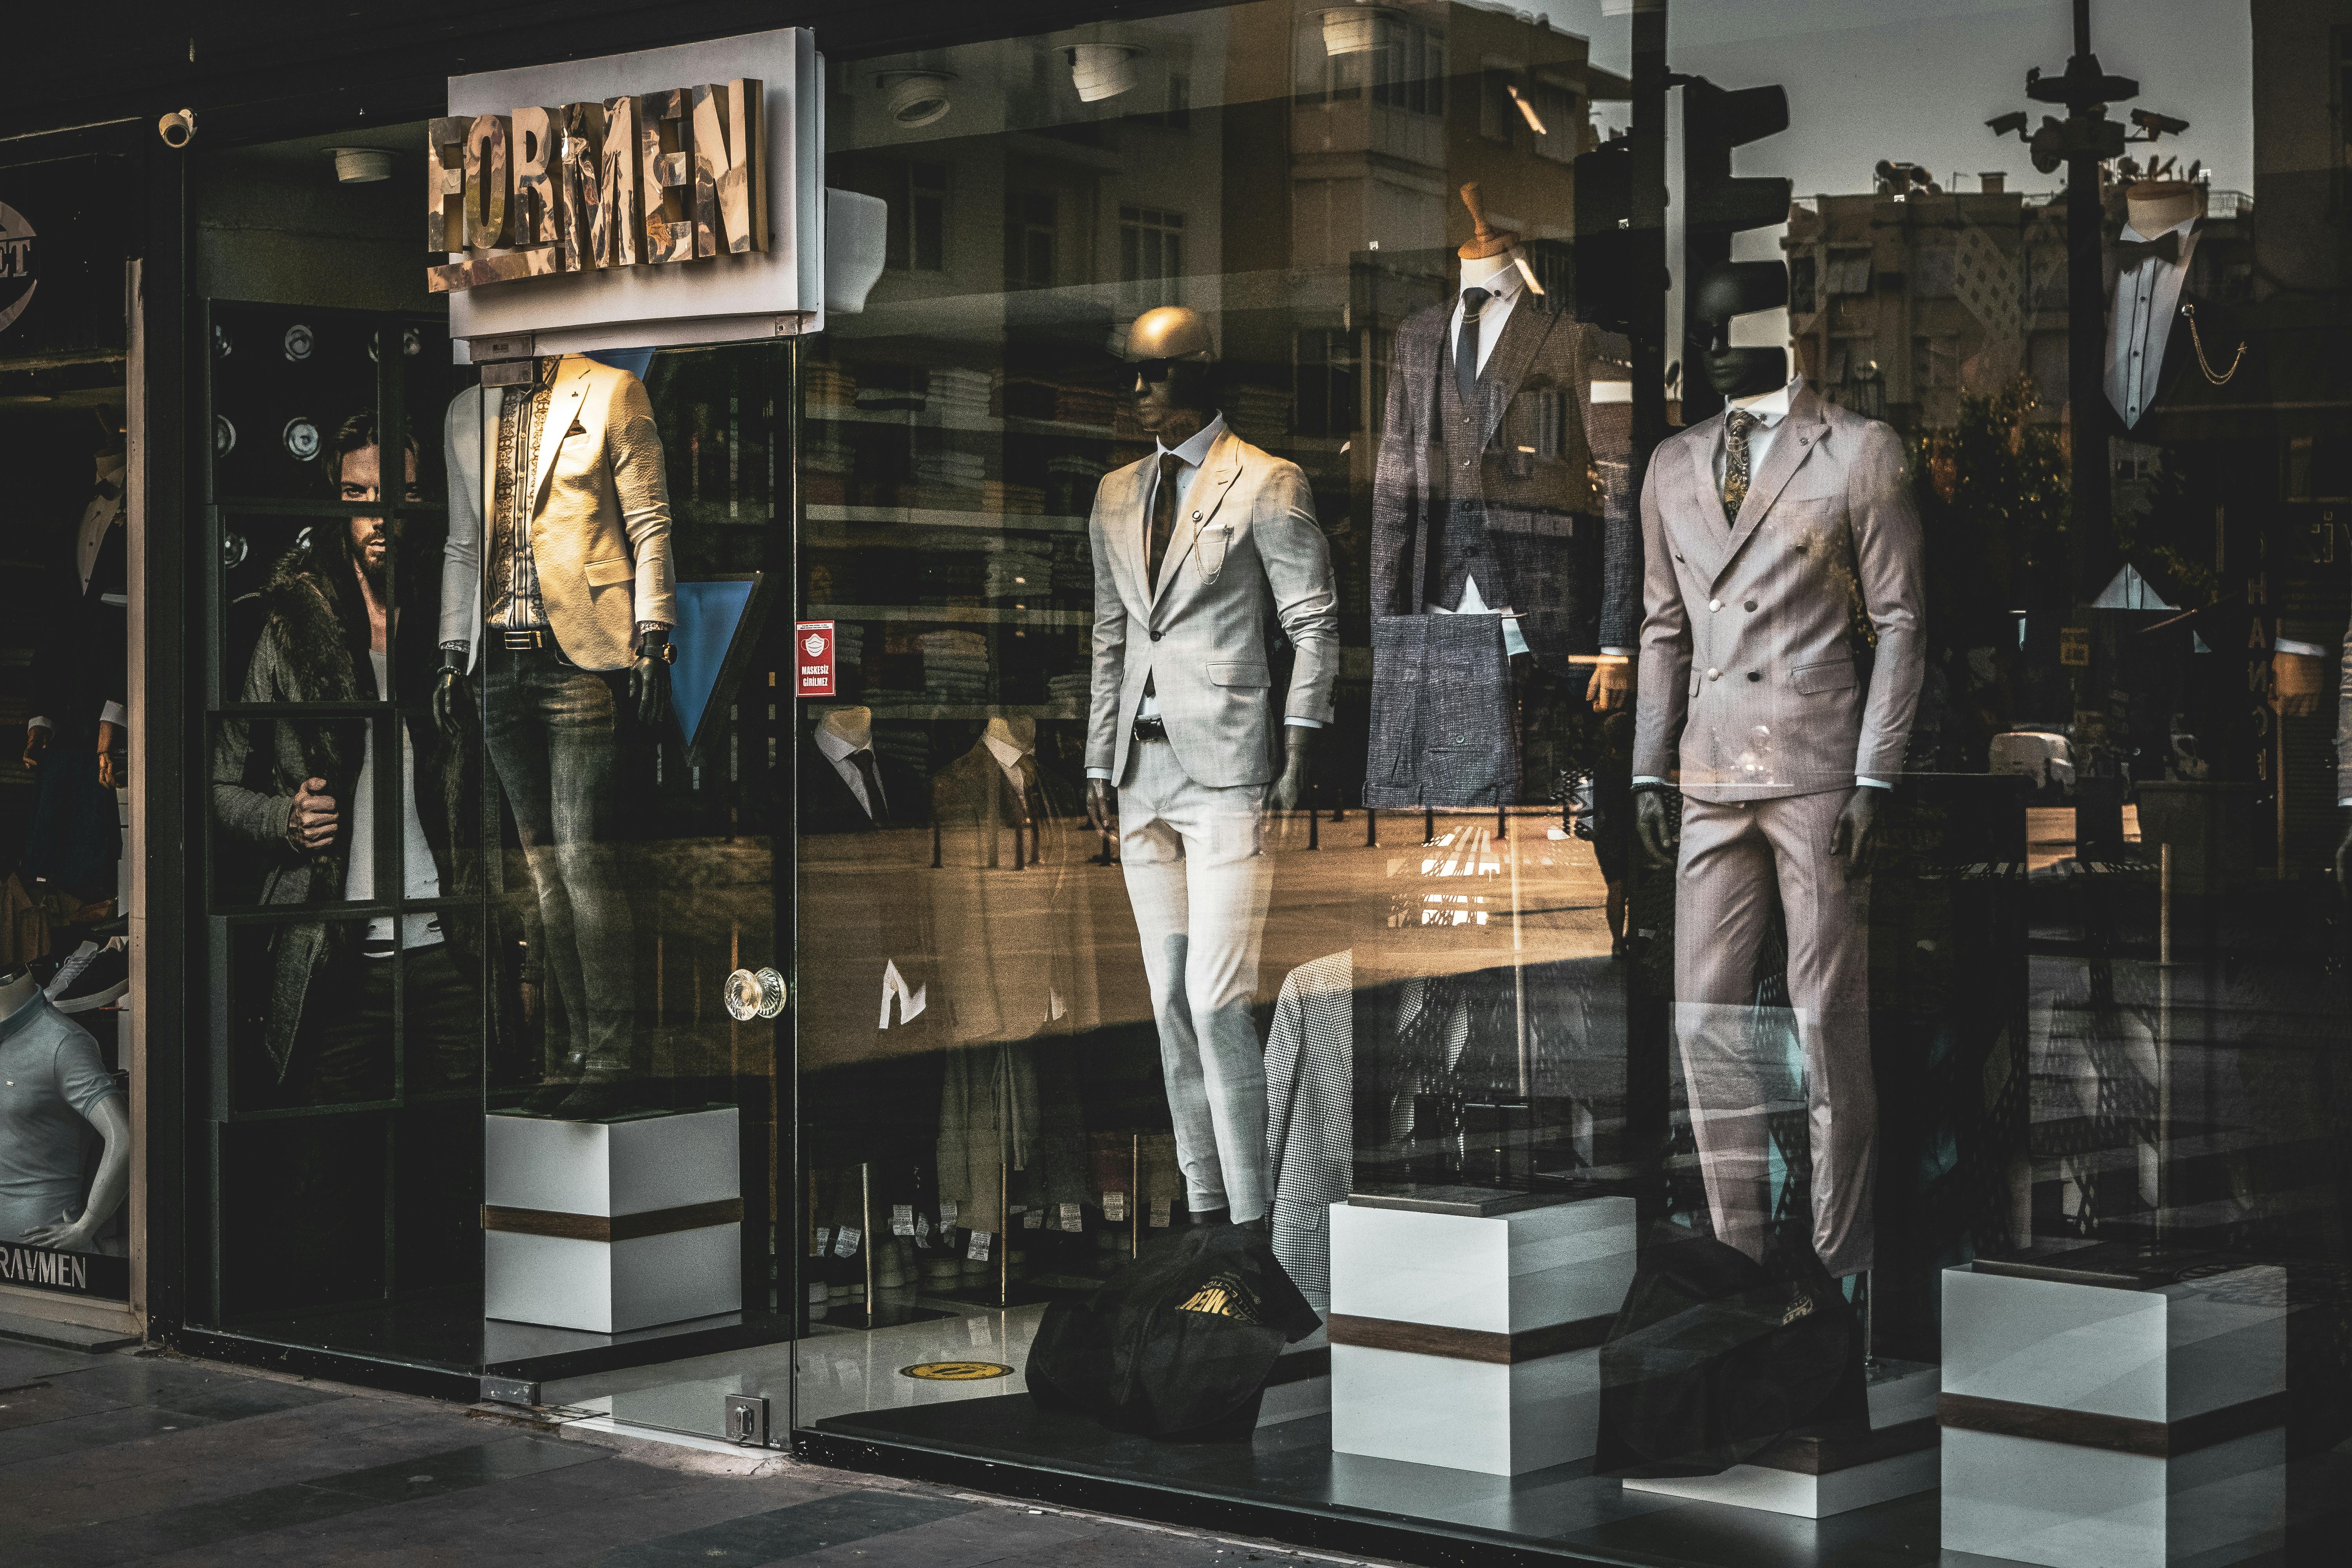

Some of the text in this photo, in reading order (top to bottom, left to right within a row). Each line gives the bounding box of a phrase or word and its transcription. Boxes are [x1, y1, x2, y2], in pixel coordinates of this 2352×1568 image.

[428, 78, 768, 272] FORMEN
[802, 664, 829, 675] MASKESİZ
[803, 677, 828, 686] GİRİLMEZ
